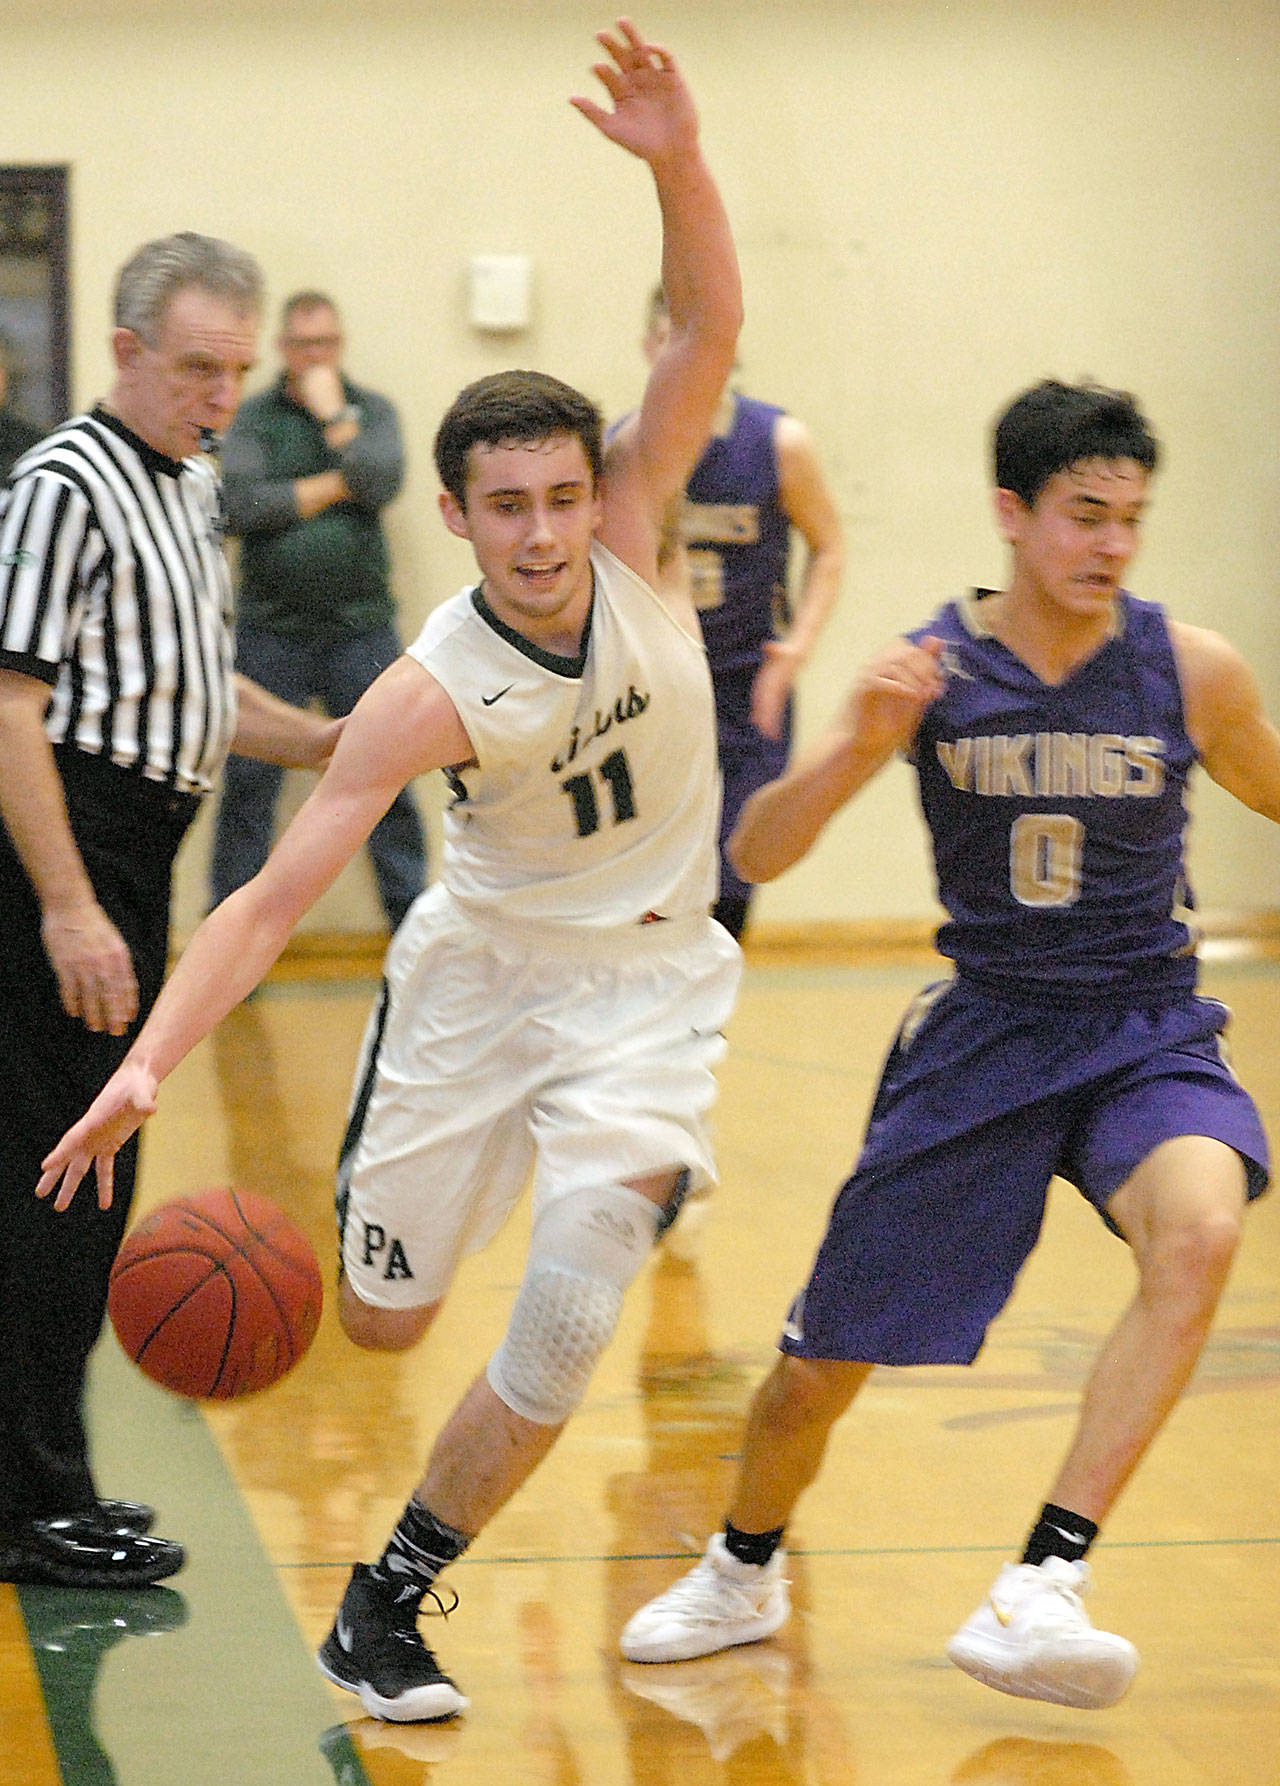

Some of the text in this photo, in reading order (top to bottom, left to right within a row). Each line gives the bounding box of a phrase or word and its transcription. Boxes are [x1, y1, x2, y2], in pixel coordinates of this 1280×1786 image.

[560, 746, 637, 837] 11
[936, 732, 1166, 798] VIKINGS
[1009, 813, 1085, 908] 0
[362, 1222, 416, 1280] PA
